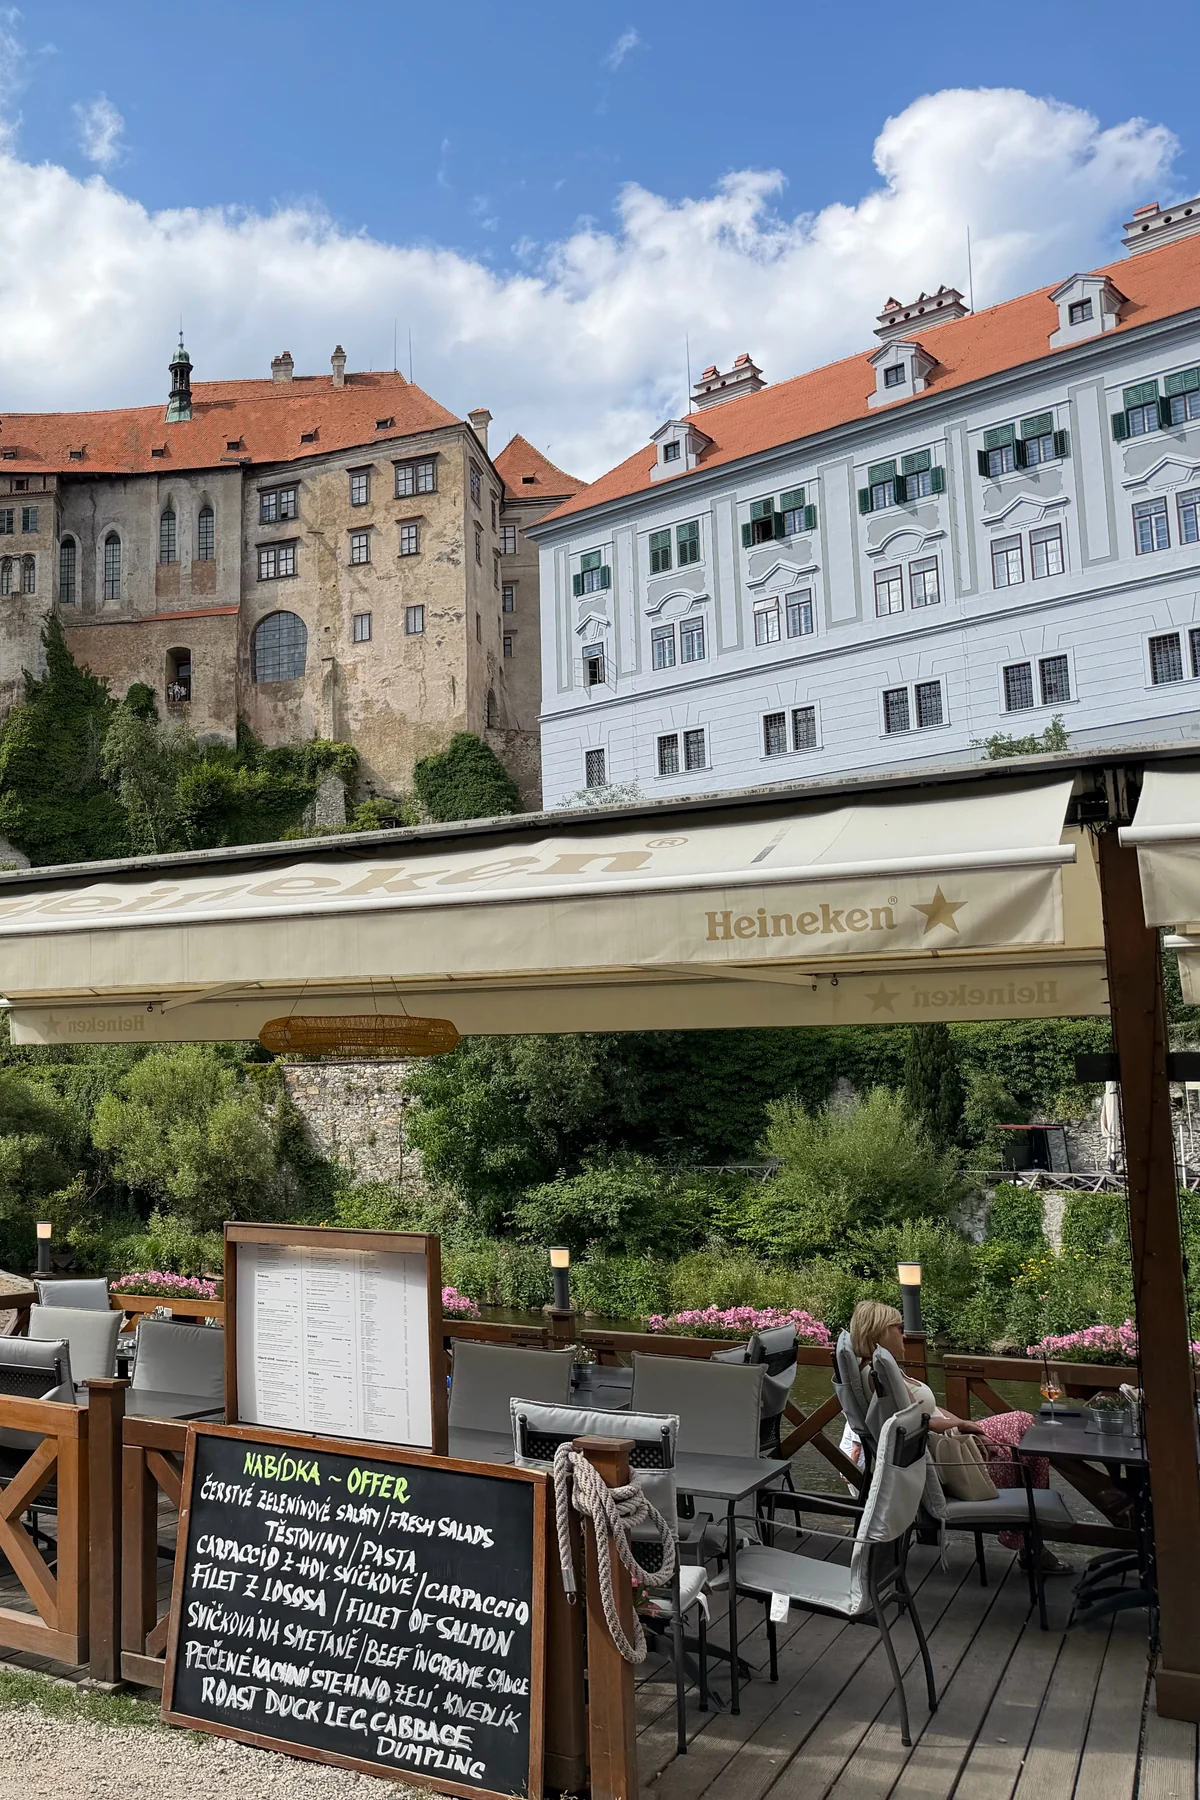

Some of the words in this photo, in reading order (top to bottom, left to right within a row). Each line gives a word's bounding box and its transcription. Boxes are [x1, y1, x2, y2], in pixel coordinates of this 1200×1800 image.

[704, 903, 898, 942] Heineken
[242, 1451, 321, 1486] NABÍDKA
[346, 1467, 411, 1504] OFFER
[200, 1472, 256, 1508] ČERSTVÉ
[437, 1516, 495, 1549] SALADS
[196, 1534, 280, 1572] CARPACCIO
[191, 1562, 243, 1592] FILET
[408, 1607, 438, 1635] OF
[435, 1616, 516, 1657] SALMON
[201, 1676, 264, 1711] ROAST
[264, 1687, 324, 1724] DUCK
[369, 1711, 476, 1752] CABBAGE
[376, 1735, 487, 1780] DUMPLING
